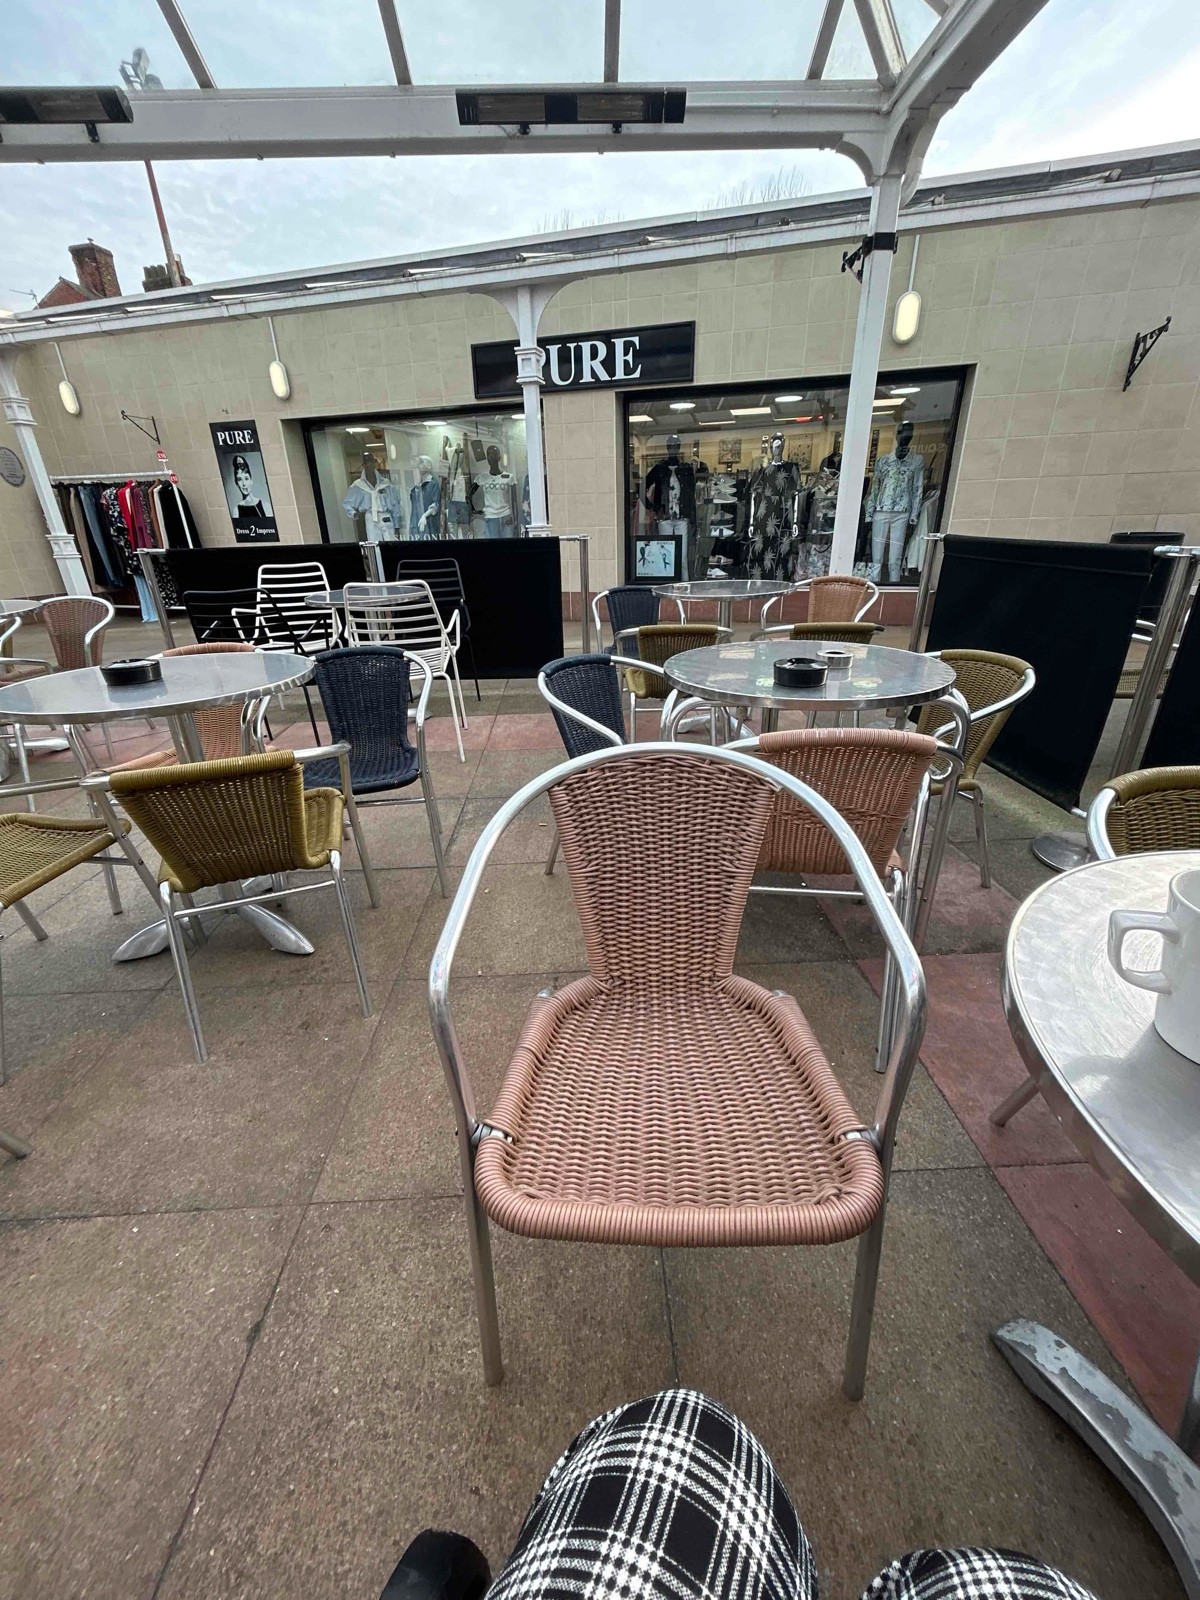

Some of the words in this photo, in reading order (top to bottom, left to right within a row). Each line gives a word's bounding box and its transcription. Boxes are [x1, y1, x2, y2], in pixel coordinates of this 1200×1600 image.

[539, 336, 642, 386] URE
[216, 430, 254, 446] PURE
[249, 525, 256, 537] 2
[256, 527, 276, 536] Impress
